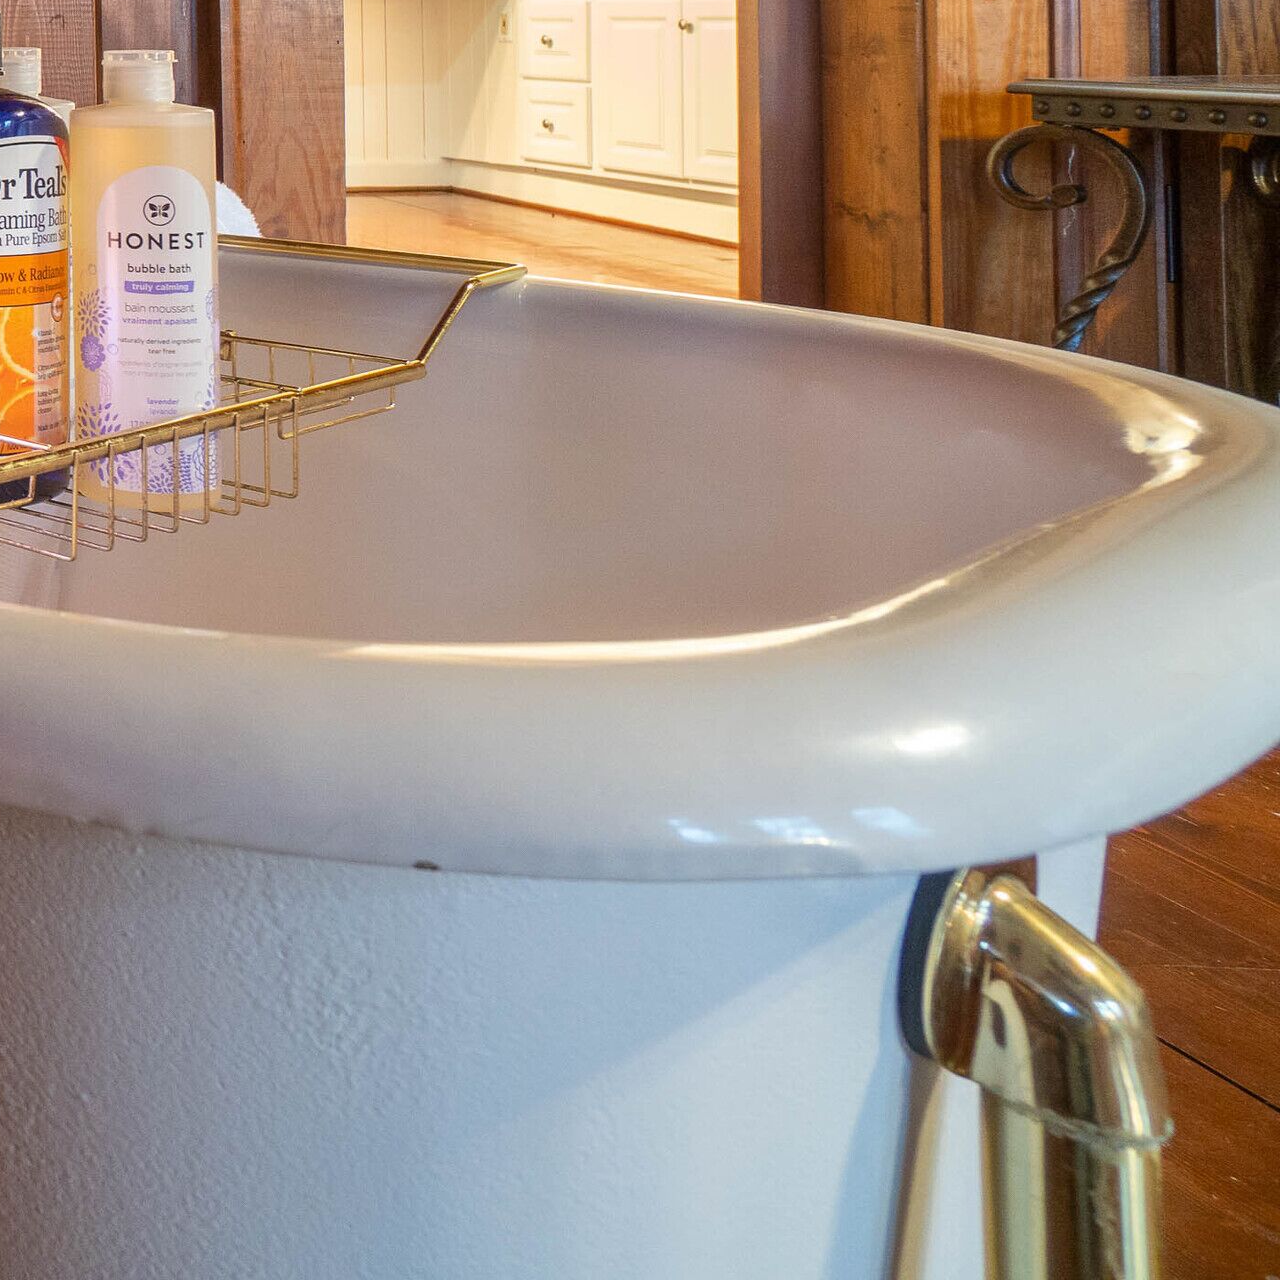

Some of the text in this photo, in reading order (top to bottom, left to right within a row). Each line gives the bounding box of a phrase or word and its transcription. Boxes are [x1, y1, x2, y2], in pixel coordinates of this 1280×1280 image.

[18, 164, 67, 200] Teal's
[48, 205, 67, 227] Bath
[5, 233, 30, 246] Pure
[32, 231, 57, 247] Epsom
[107, 231, 204, 250] HONEST
[127, 263, 192, 274] bubble bath
[17, 268, 27, 282] &
[131, 283, 189, 292] truly calming
[124, 303, 195, 314] bain moussant
[122, 317, 197, 326] vraiment apaisant
[146, 337, 170, 345] derived
[146, 397, 179, 405] lavender
